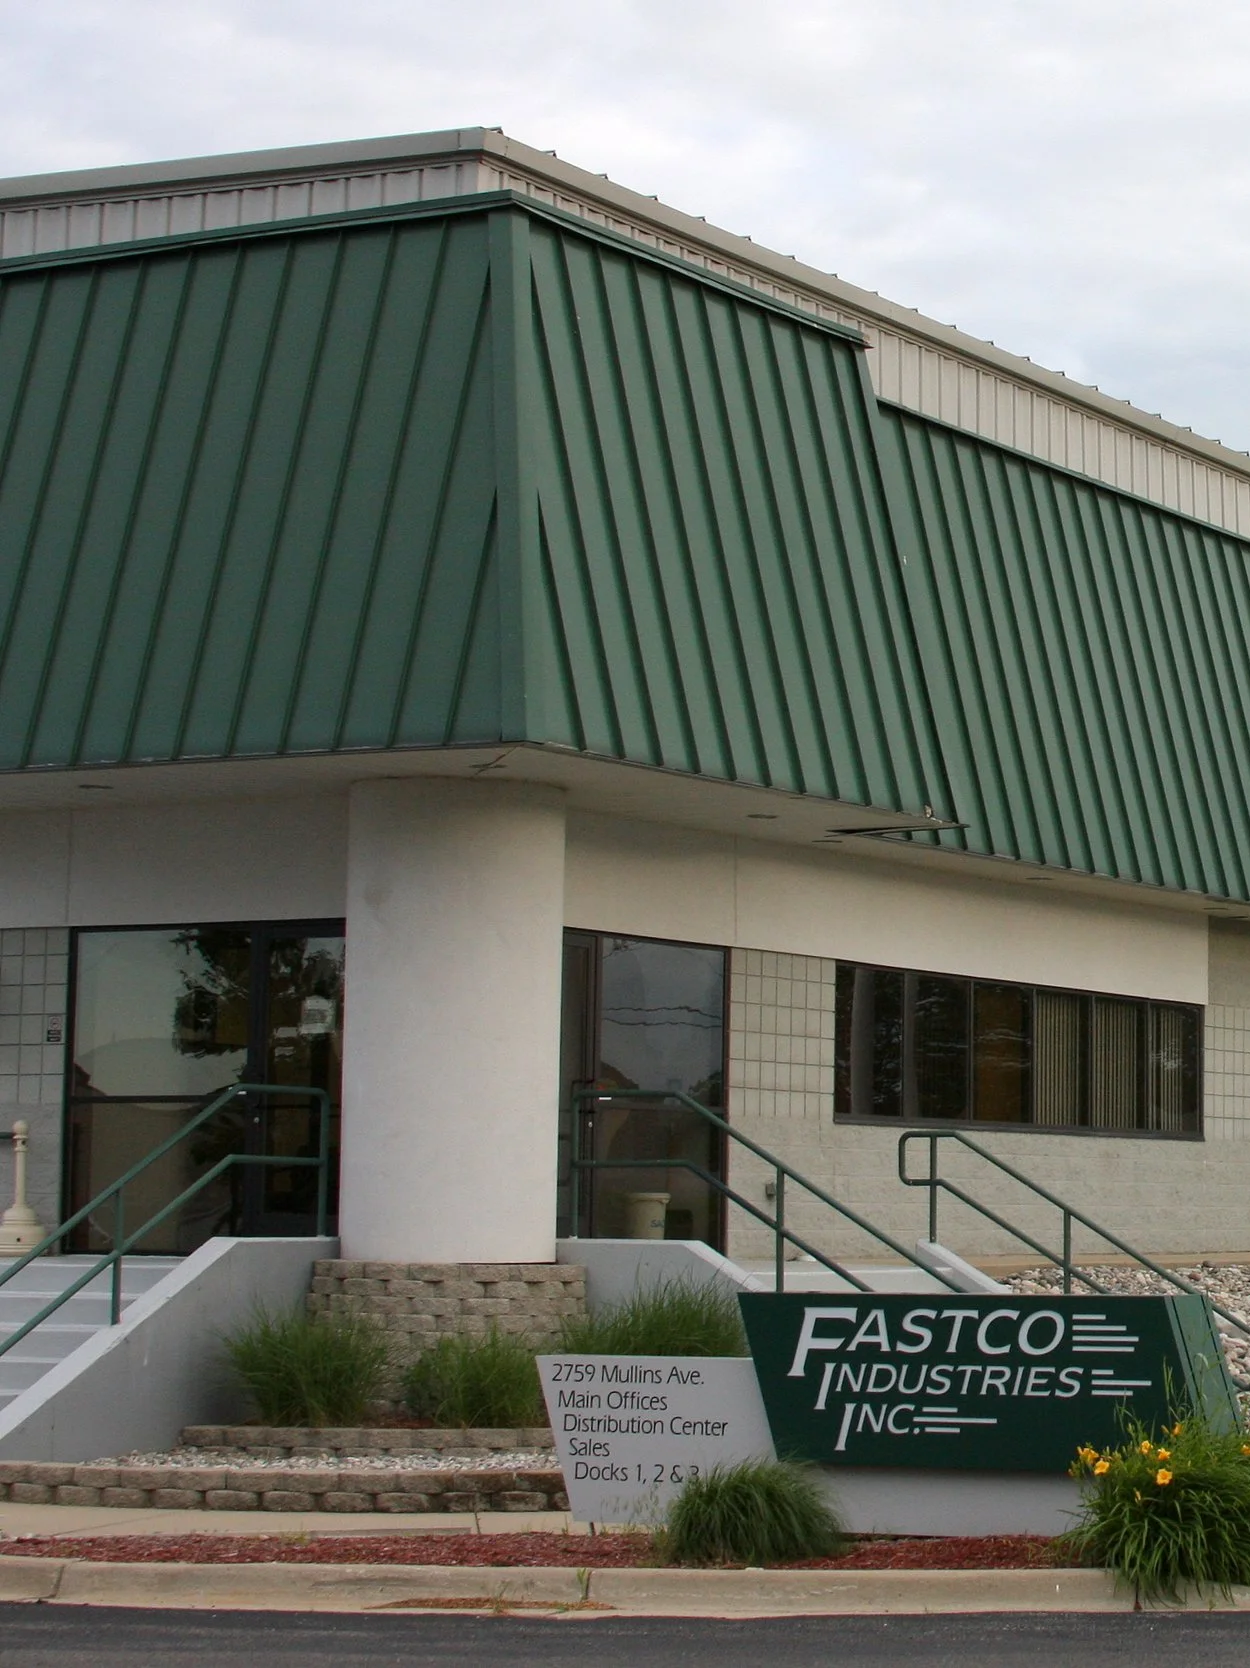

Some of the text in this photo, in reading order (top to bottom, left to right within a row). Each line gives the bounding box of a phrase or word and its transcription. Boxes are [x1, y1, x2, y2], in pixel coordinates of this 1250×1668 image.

[786, 1306, 1066, 1377] FASTCO
[552, 1364, 704, 1385] 2759 Mullins Ave.
[814, 1363, 1083, 1411] INDUSTRIES
[558, 1390, 667, 1410] Main Offices
[564, 1414, 728, 1436] Distribution Center
[835, 1403, 921, 1450] INC.
[569, 1438, 610, 1457] Sales
[575, 1462, 628, 1481] Docks
[637, 1464, 646, 1484] 1,
[653, 1464, 664, 1482] 2
[670, 1465, 683, 1483] &
